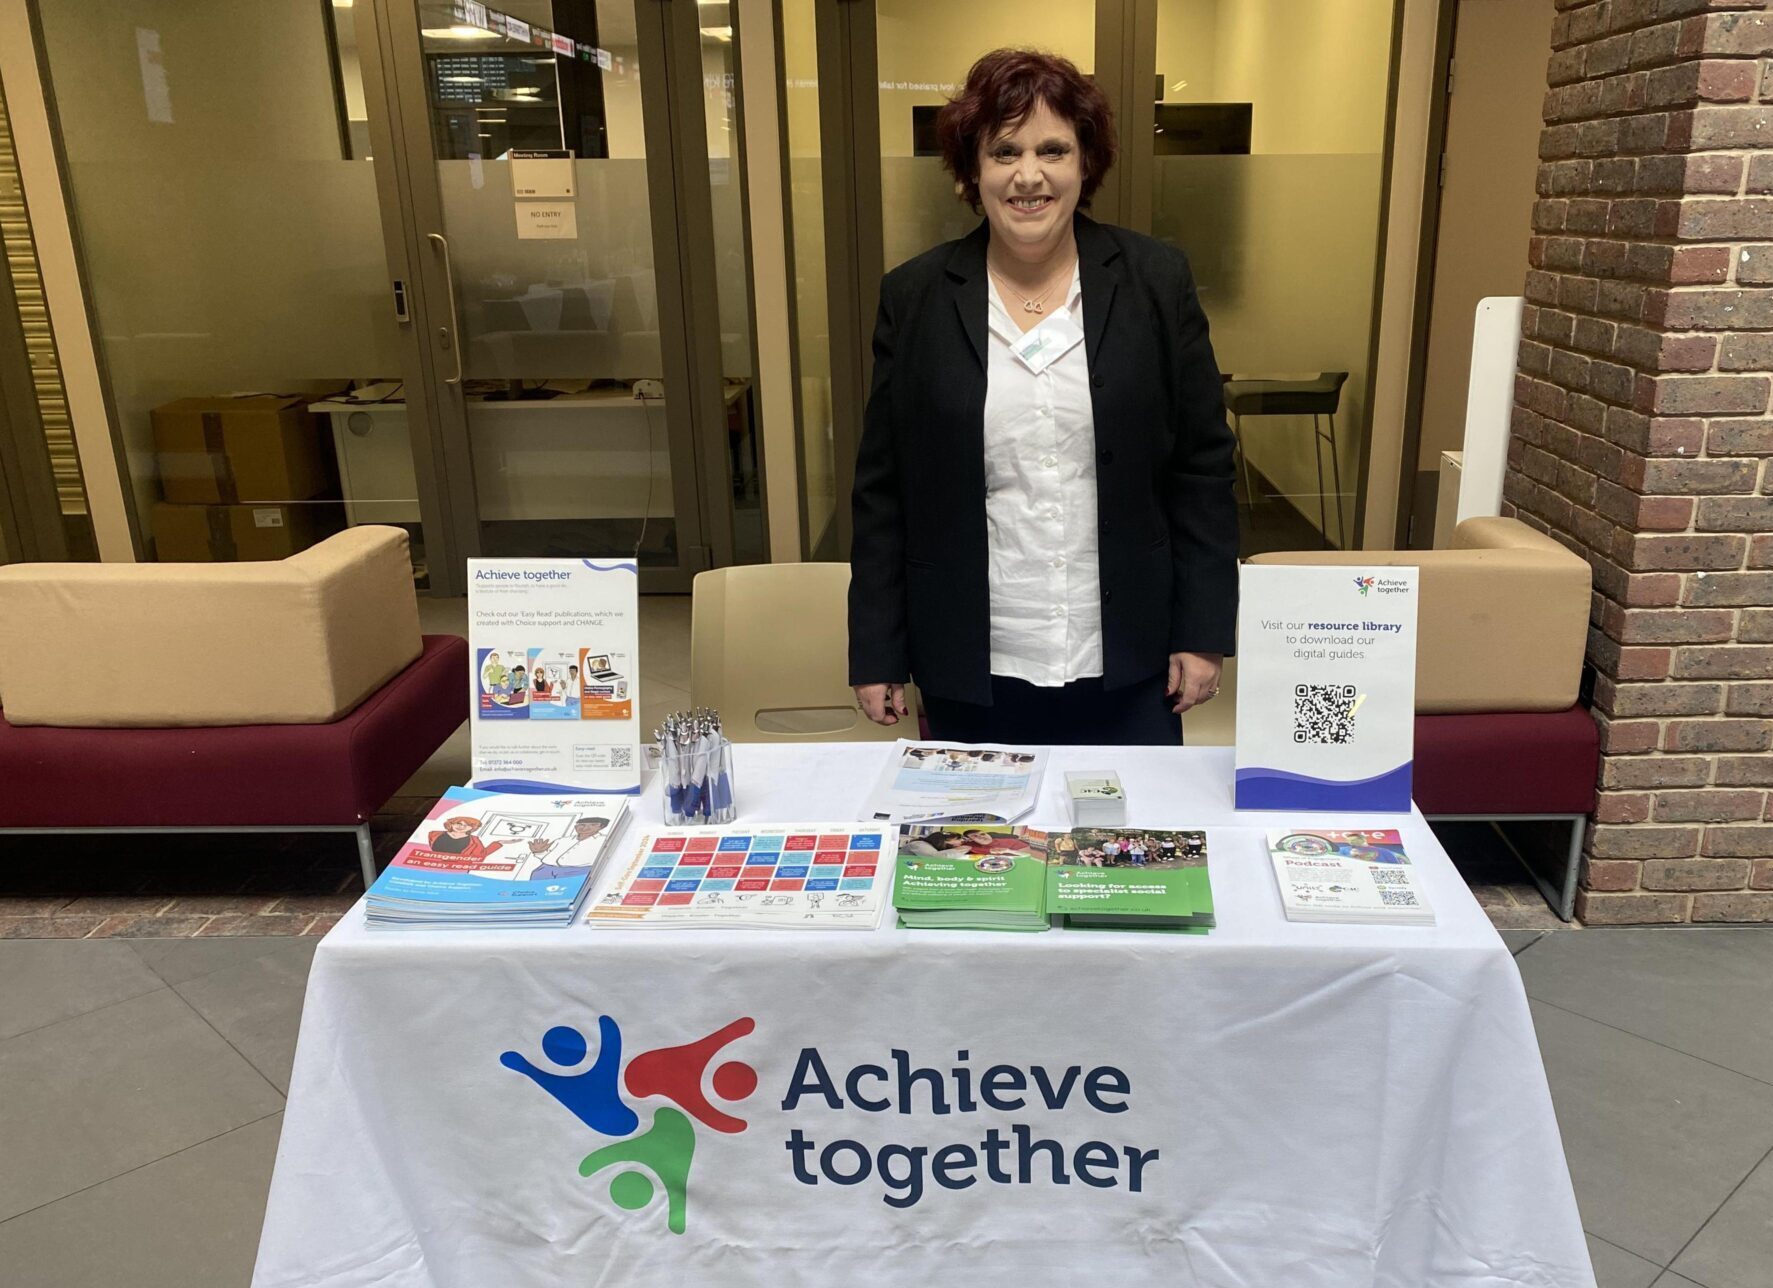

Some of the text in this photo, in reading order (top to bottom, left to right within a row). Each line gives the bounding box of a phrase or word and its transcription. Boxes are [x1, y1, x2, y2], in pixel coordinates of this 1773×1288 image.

[476, 570, 572, 582] Achieve together
[1378, 586, 1409, 594] together
[554, 611, 592, 619] publications,
[538, 620, 562, 628] support
[1262, 620, 1402, 633] Visit our resource library
[1287, 634, 1375, 645] to download our
[1294, 649, 1364, 660] digital guides
[412, 850, 483, 863] Transgender
[418, 861, 448, 870] easy
[451, 863, 476, 871] read
[479, 863, 514, 872] guide
[1284, 860, 1343, 868] Podcast
[1058, 882, 1106, 890] Looking
[782, 1048, 1131, 1116] Achieve
[785, 1124, 1159, 1209] together
